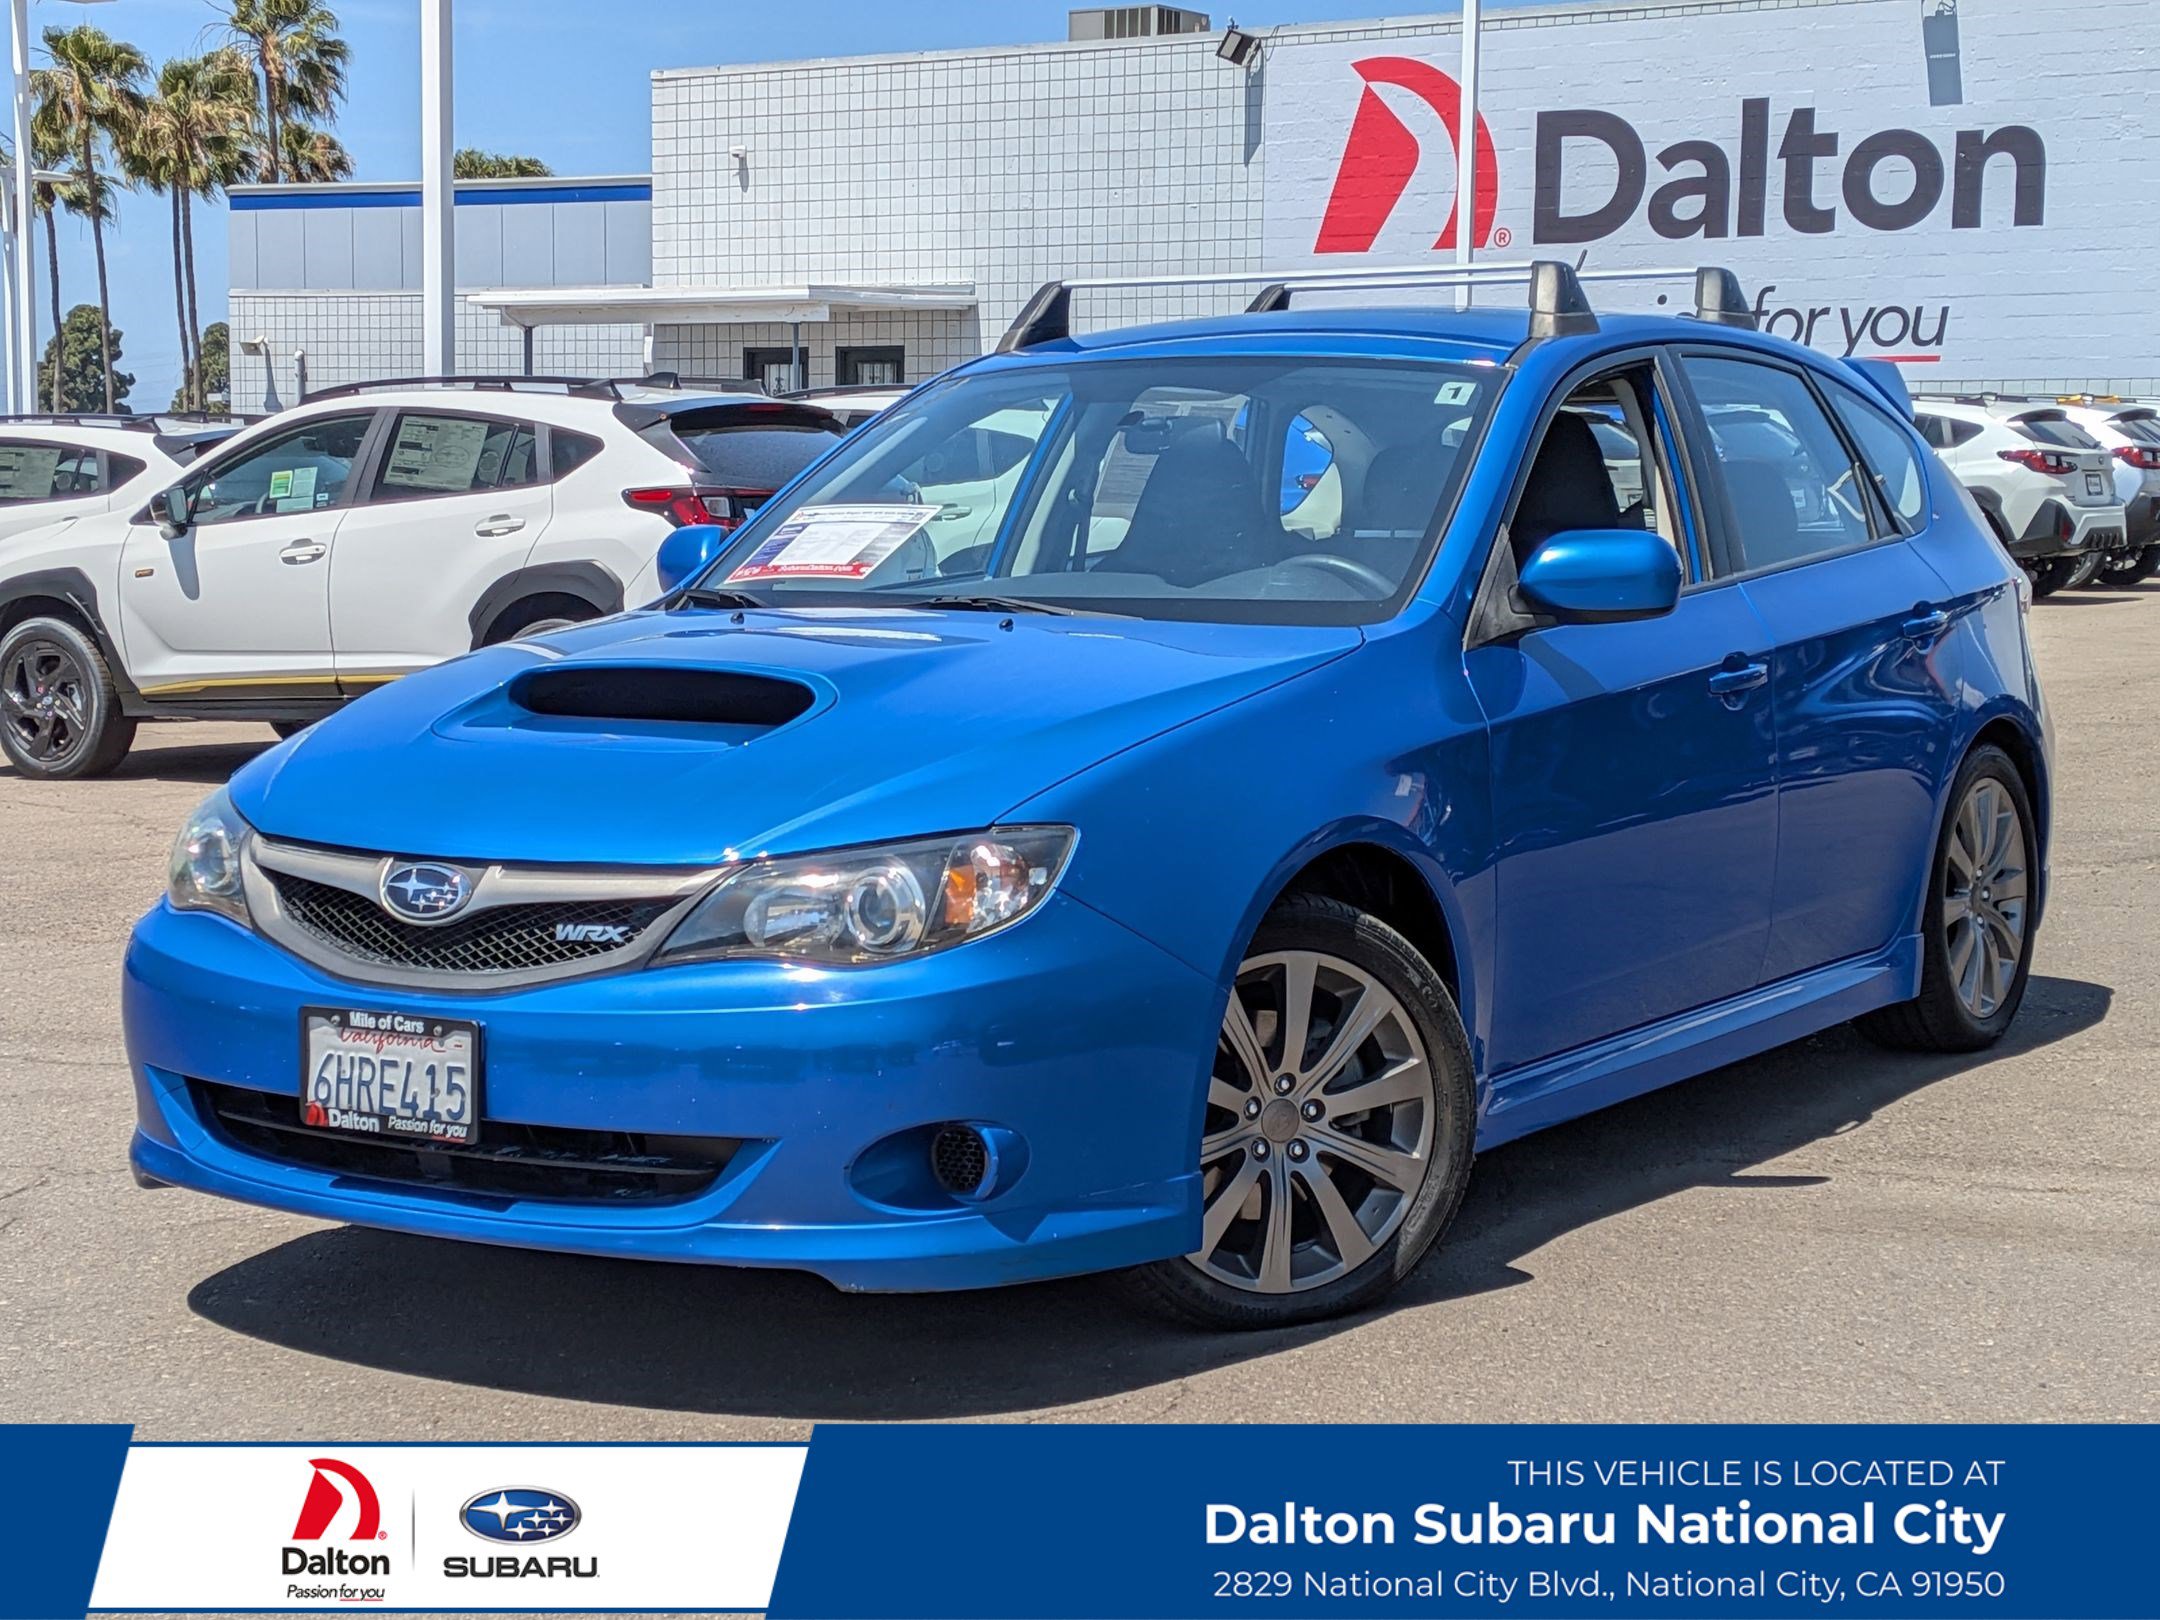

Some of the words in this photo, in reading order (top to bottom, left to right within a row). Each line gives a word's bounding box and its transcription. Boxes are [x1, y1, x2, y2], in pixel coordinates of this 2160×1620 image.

[1533, 97, 2046, 245] Dalton
[1754, 285, 1830, 347] for
[1840, 305, 1950, 358] you
[1447, 385, 1463, 400] 1
[555, 923, 630, 942] WRX
[349, 1011, 376, 1029] Mile
[377, 1016, 392, 1031] of
[394, 1017, 425, 1034] Cars
[314, 1052, 467, 1121] 6HRE415
[327, 1108, 381, 1133] Dalton
[387, 1115, 429, 1134] Passion
[428, 1119, 446, 1136] for
[445, 1123, 468, 1138] you
